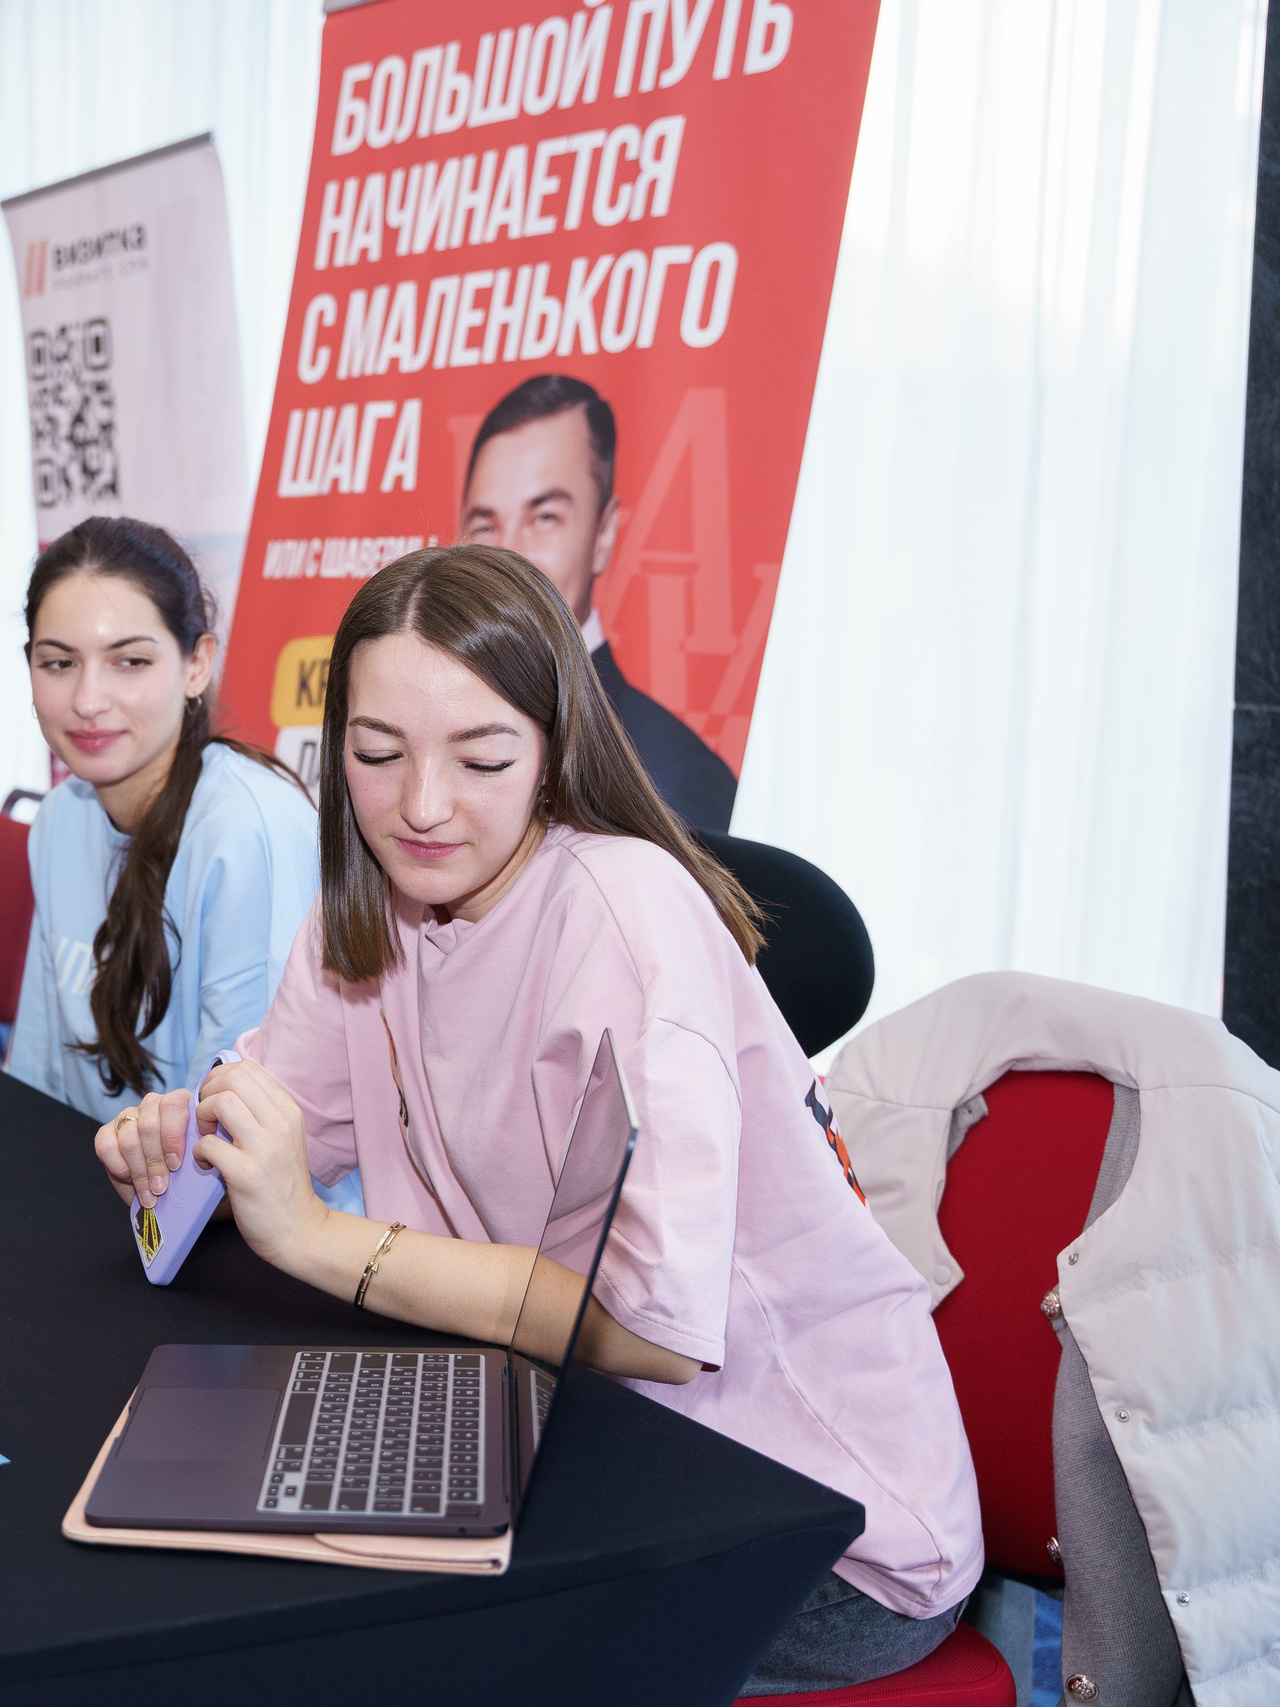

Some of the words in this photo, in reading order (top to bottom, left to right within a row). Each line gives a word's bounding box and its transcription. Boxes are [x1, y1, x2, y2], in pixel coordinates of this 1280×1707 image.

[330, 0, 614, 157] БОЛЬШОЙ
[613, 0, 794, 99] ПУТЬ
[313, 113, 687, 271] НАЧИНАЕТСЯ
[296, 292, 337, 384] С
[336, 240, 739, 381] МАЛЕНЬКОГО
[275, 398, 423, 499] ШАГА
